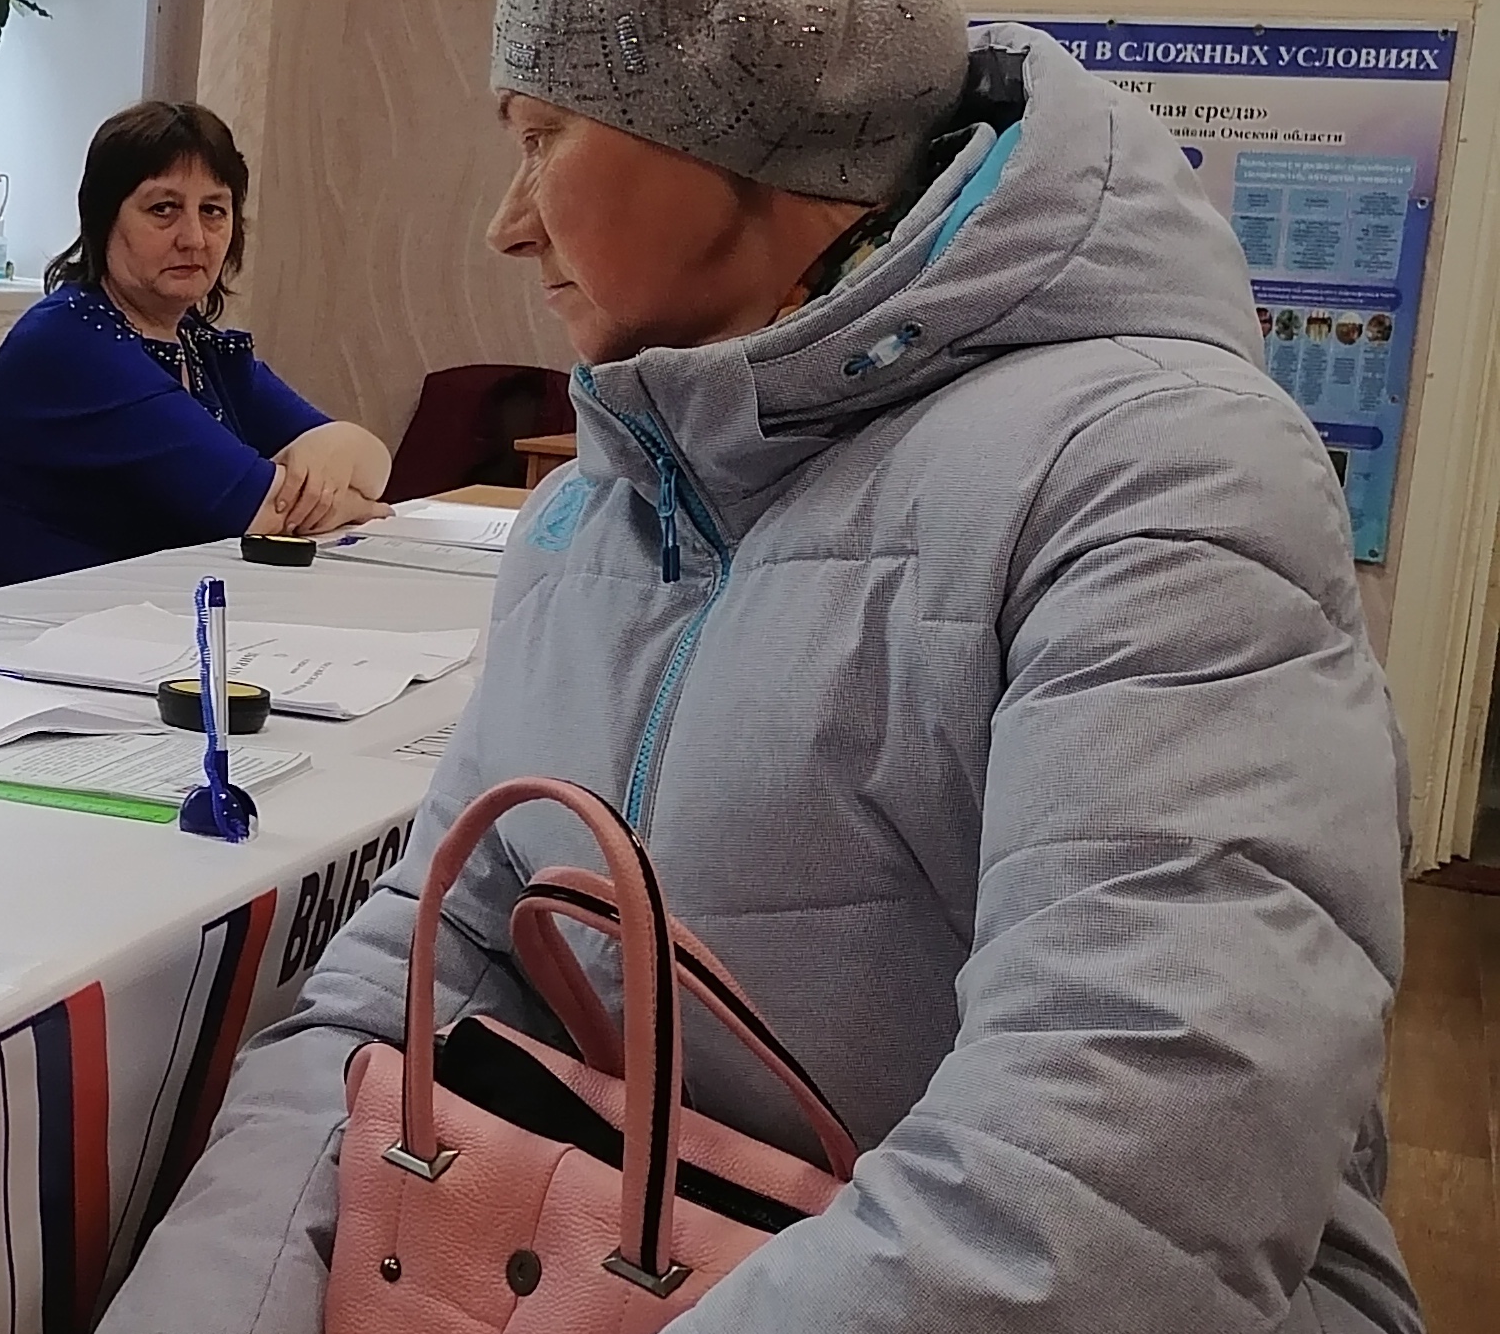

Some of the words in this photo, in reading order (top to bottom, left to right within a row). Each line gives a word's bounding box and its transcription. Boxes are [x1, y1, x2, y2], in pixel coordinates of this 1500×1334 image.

[1095, 40, 1112, 61] В
[1118, 41, 1269, 66] СЛОЖНЫХ
[1277, 45, 1440, 71] УСЛОВИЯХ
[1194, 105, 1268, 123] среда»
[1169, 128, 1216, 139] айона
[1220, 127, 1279, 141] Омской
[1283, 129, 1343, 143] области
[277, 817, 415, 988] ВЫБО
